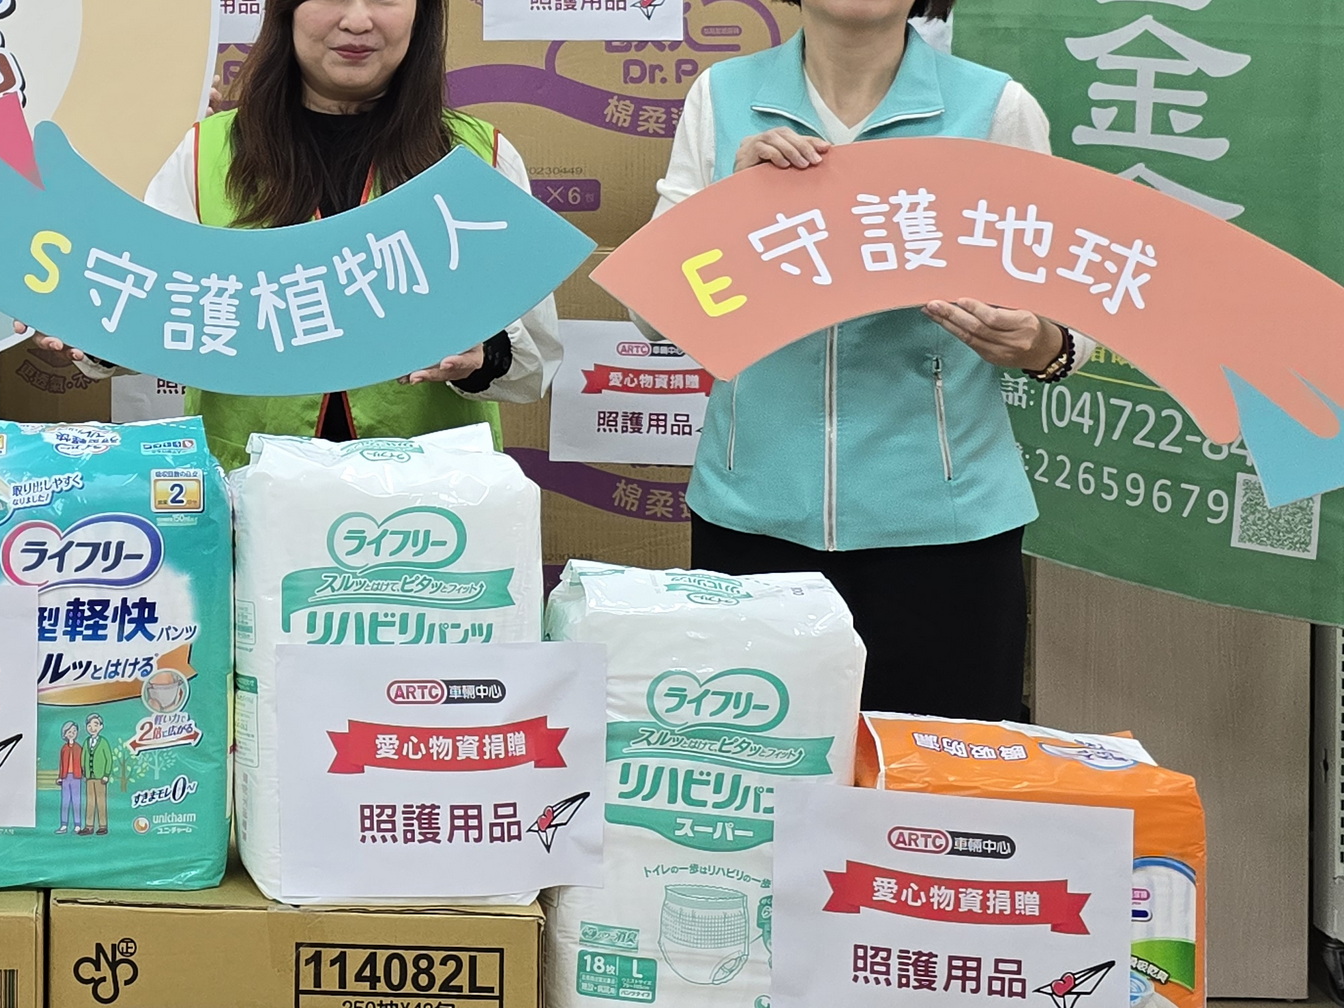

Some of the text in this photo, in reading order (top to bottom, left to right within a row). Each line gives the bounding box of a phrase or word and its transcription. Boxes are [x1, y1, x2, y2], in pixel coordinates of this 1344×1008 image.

[623, 59, 698, 85] Dr. P
[621, 345, 647, 354] ARTC
[608, 371, 700, 389] 愛心物資捐贈
[596, 410, 693, 437] 照護用品
[169, 483, 185, 505] 2
[19, 540, 144, 573] ライフリー
[343, 529, 448, 557] ライフリー
[305, 611, 494, 645] リハビリパンツ
[393, 684, 503, 700] ARTC 車輛中心
[662, 686, 770, 720] ライフリー
[374, 731, 527, 761] 愛心物資捐贈
[152, 813, 197, 824] unicharm
[358, 801, 523, 845] 照護用品
[673, 818, 754, 841] スーパー
[893, 830, 1012, 855] ARTC 車輛中心
[872, 876, 1042, 917] 愛心物資捐贈
[304, 949, 495, 993] 114082L
[583, 954, 616, 976] 18枚
[632, 959, 643, 979] L
[851, 942, 1028, 999] 照護用品
